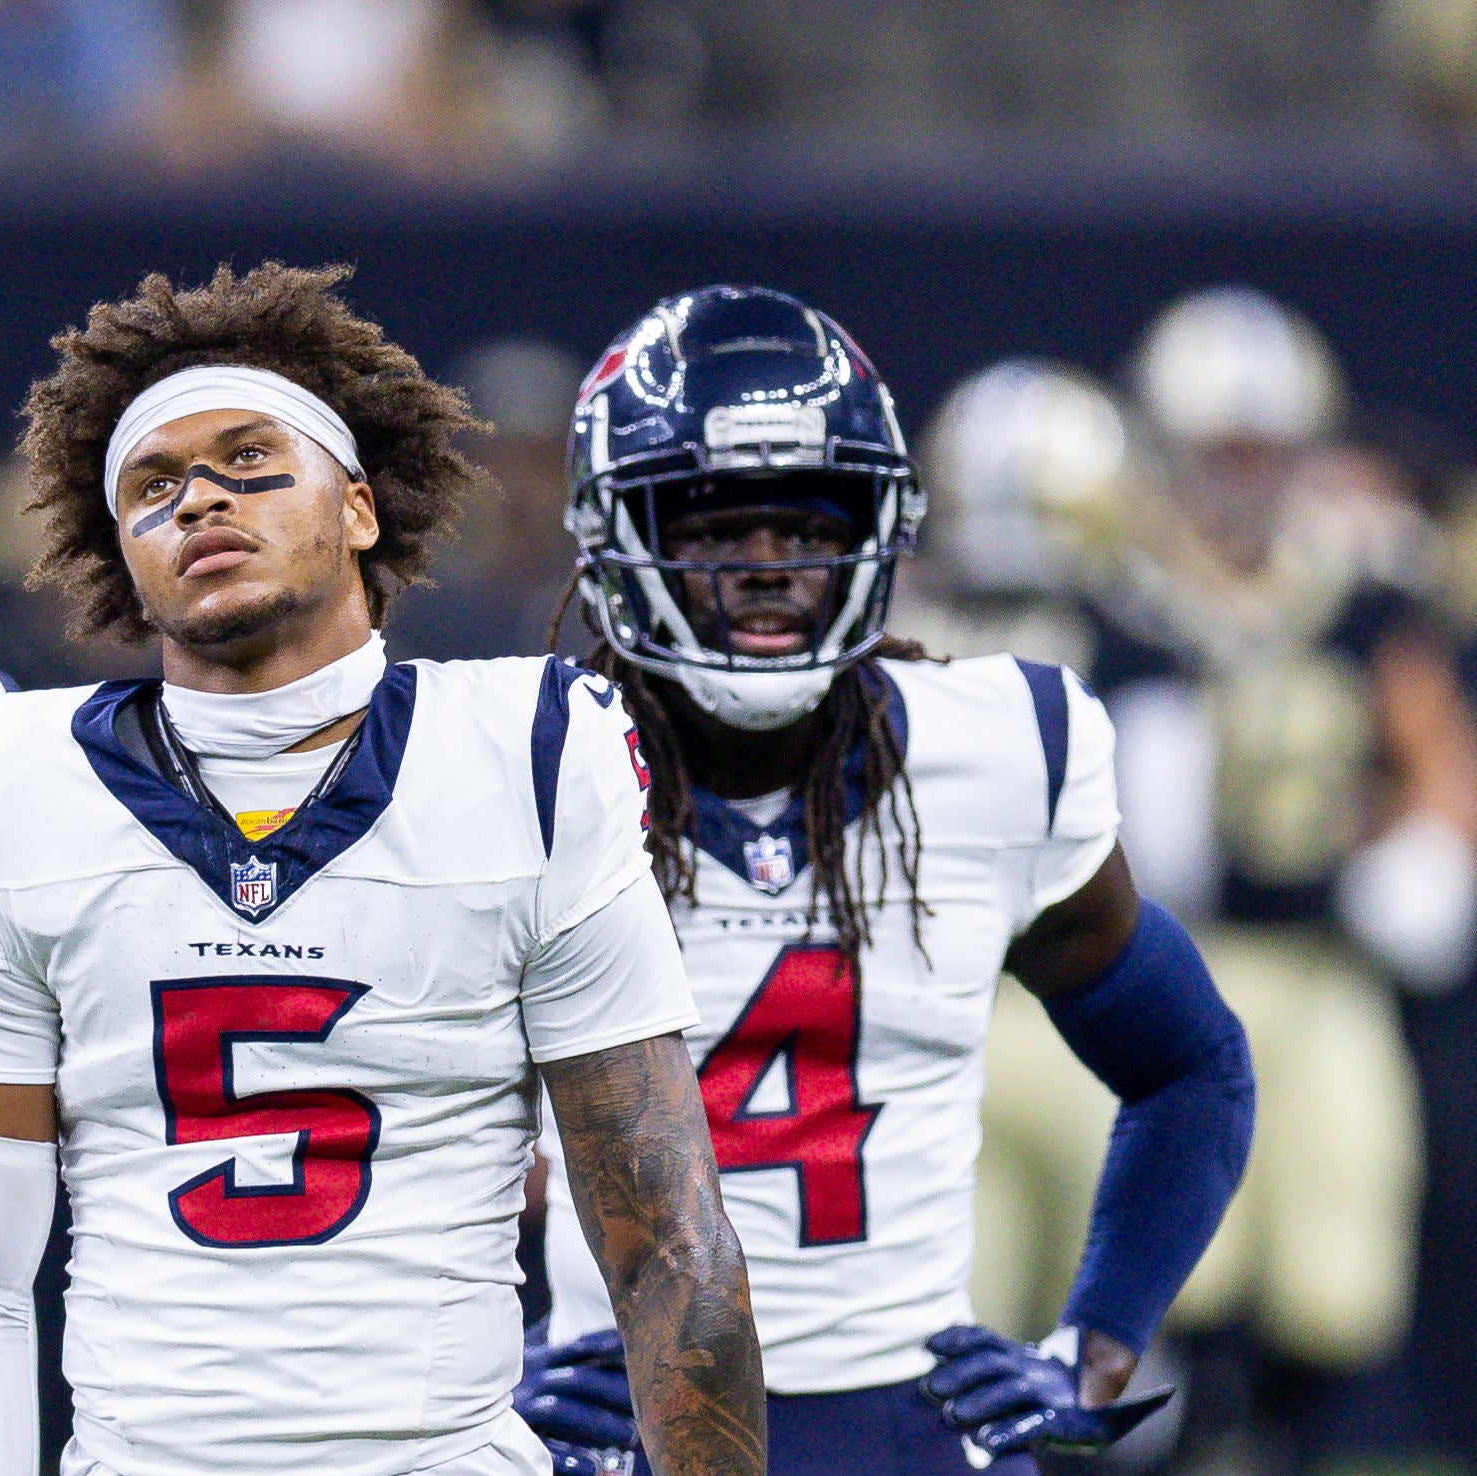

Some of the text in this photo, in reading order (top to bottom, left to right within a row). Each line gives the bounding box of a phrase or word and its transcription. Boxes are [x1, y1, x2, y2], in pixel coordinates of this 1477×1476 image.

[188, 942, 327, 960] TEXANS
[238, 883, 270, 904] NFL
[149, 974, 383, 1250] 5
[697, 942, 886, 1249] 4
